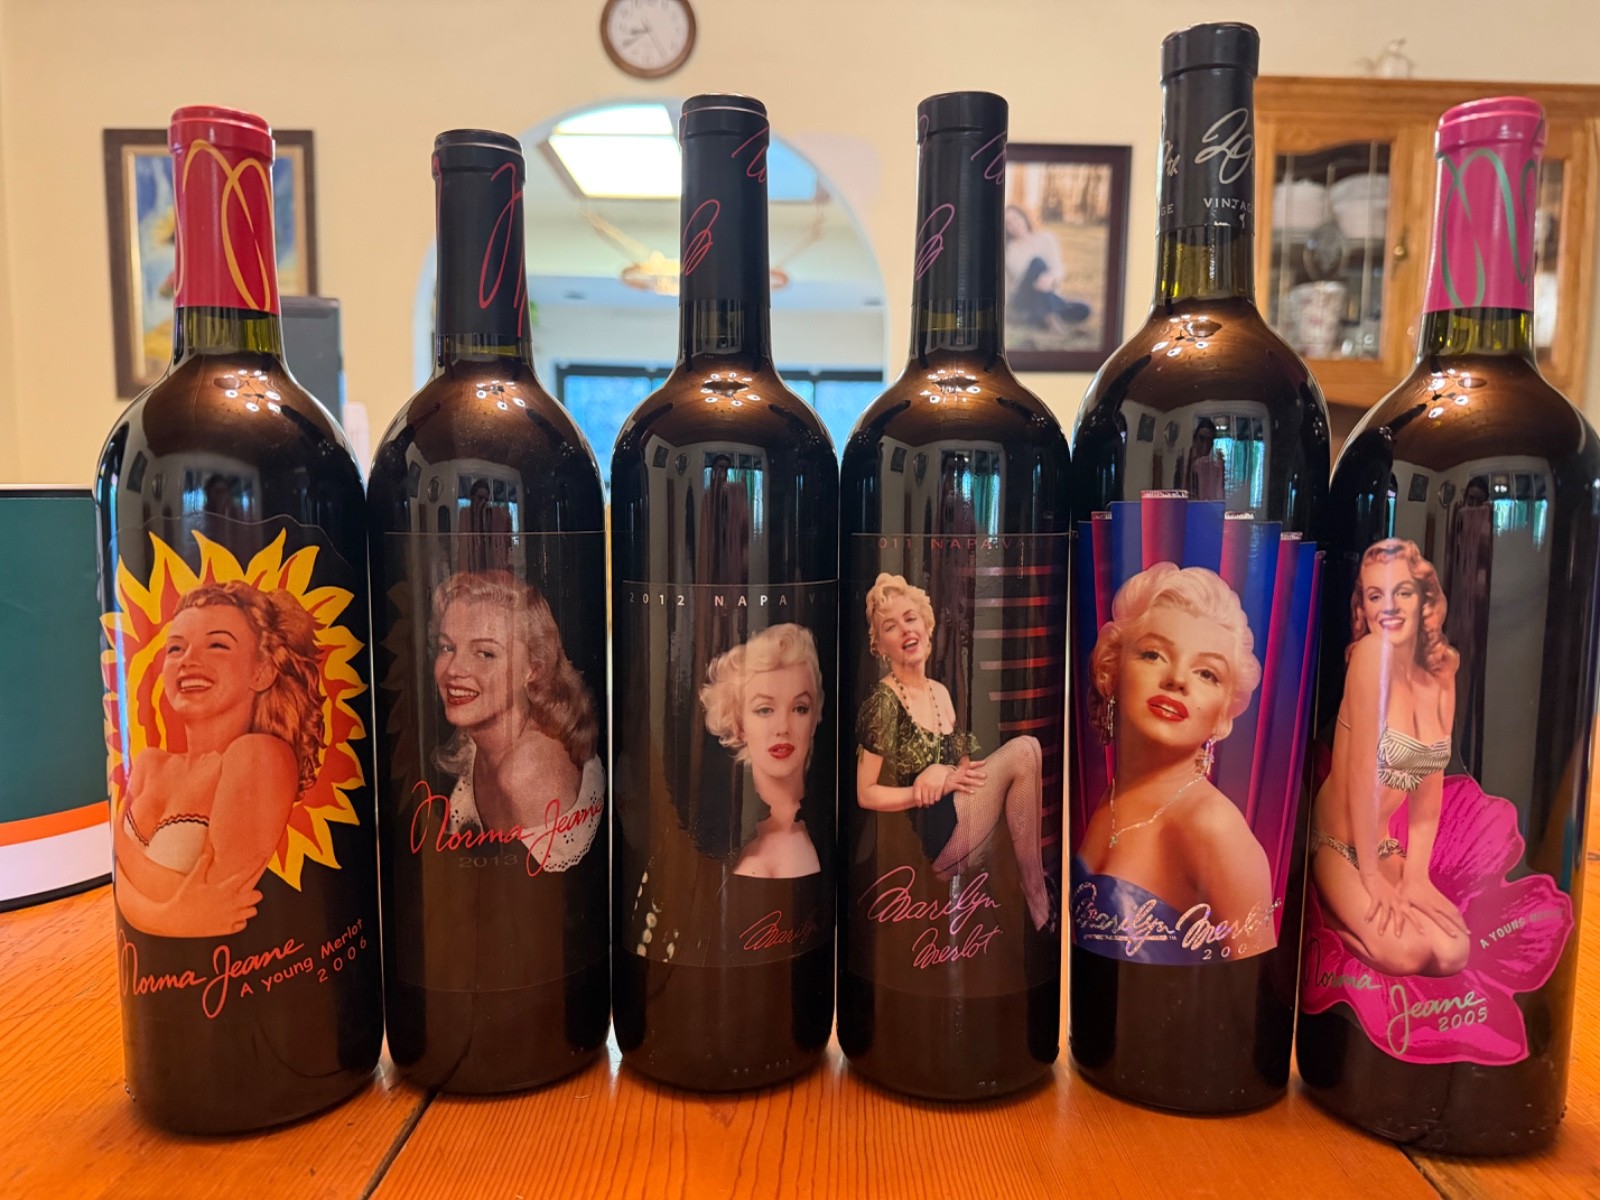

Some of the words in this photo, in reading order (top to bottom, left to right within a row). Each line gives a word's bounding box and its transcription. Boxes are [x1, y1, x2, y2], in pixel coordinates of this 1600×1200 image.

[1203, 198, 1252, 213] VINTAG
[871, 537, 912, 549] 011
[930, 536, 999, 549] NAPA
[629, 592, 685, 606] 2012
[714, 594, 788, 607] NAPA
[409, 780, 534, 854] Norma
[458, 854, 518, 868] 2013
[857, 865, 1002, 936] Marilyn
[911, 923, 1004, 969] Merlot
[1175, 897, 1282, 951] Merl
[1479, 938, 1490, 949] A
[1488, 916, 1527, 942] YOUNG
[119, 928, 207, 997] Norma
[202, 937, 305, 1019] Jeane
[240, 982, 254, 998] A
[261, 956, 314, 992] young
[320, 917, 363, 960] Merlot
[317, 936, 368, 984] 2006
[1202, 943, 1261, 960] 200
[1387, 984, 1487, 1055] Jeane
[1437, 1006, 1489, 1032] 2005
